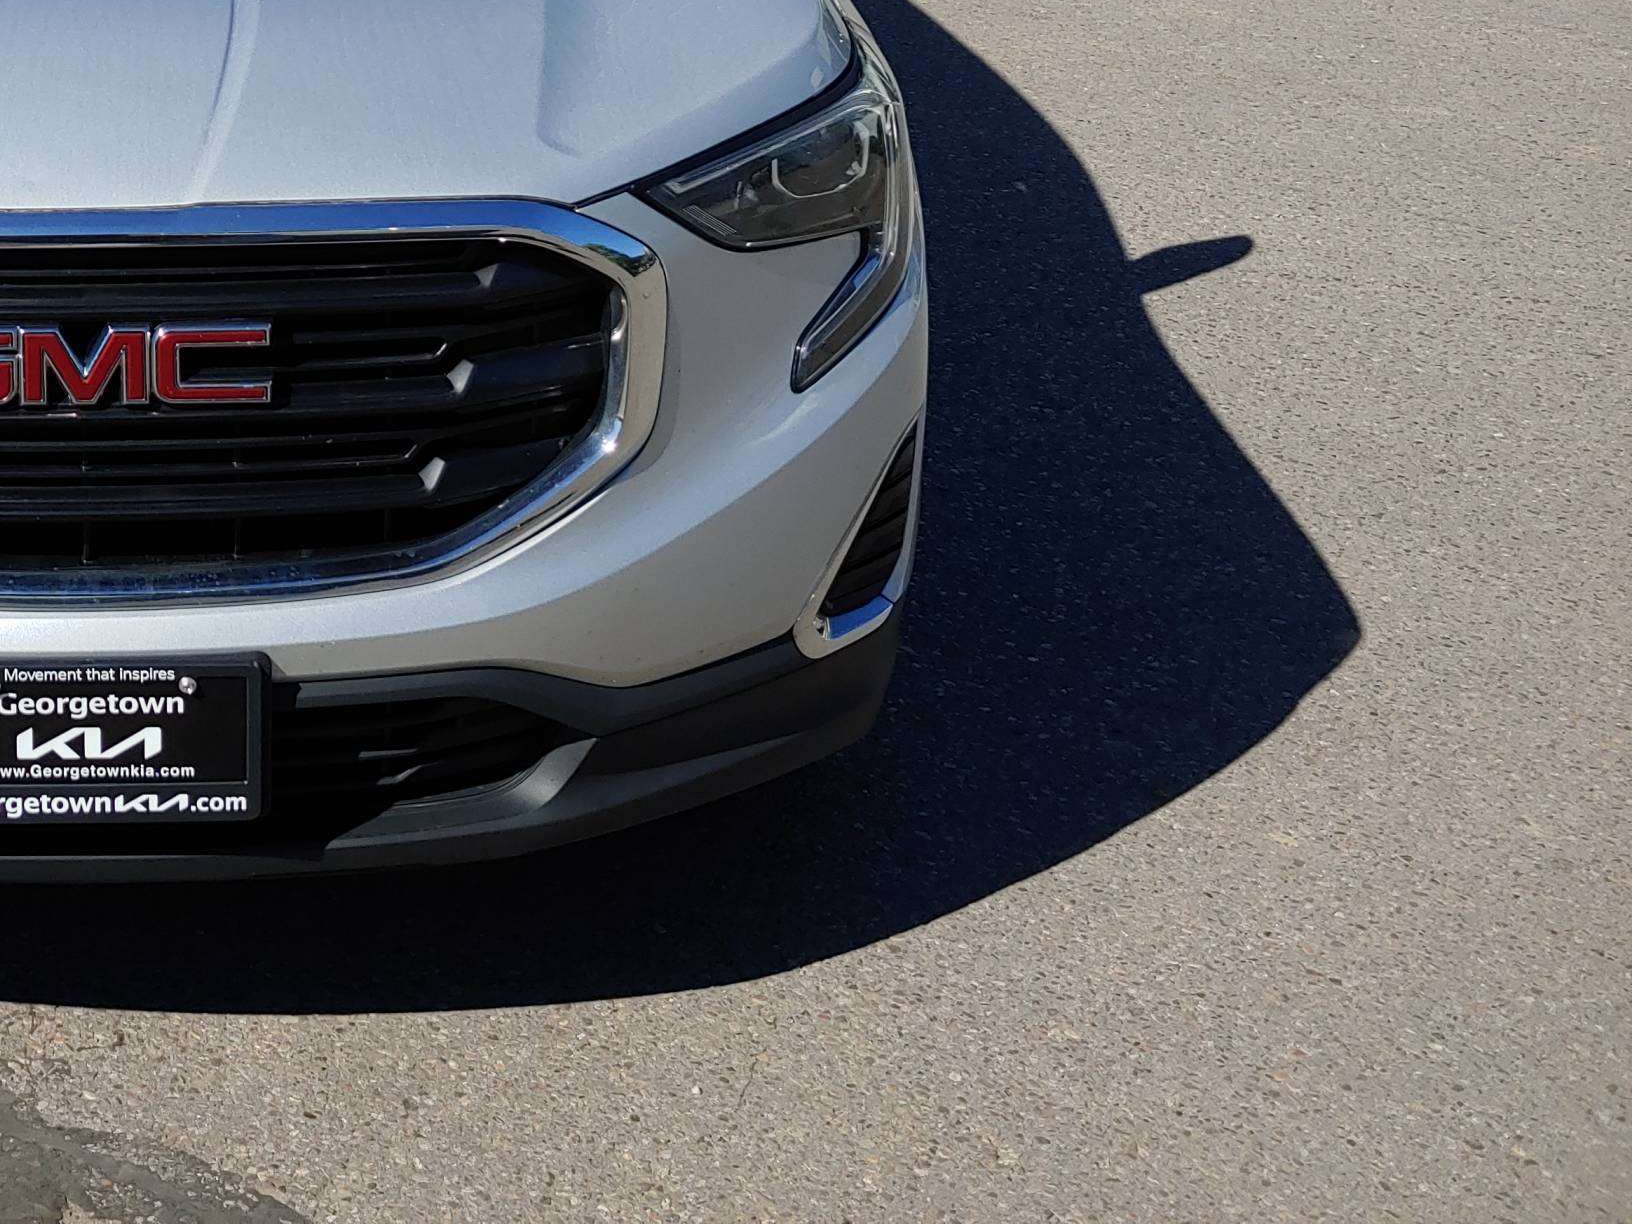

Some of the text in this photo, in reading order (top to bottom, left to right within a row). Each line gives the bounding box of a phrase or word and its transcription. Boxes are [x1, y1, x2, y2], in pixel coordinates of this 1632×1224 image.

[4, 668, 175, 684] Movement that inspires
[16, 726, 163, 760] KIA
